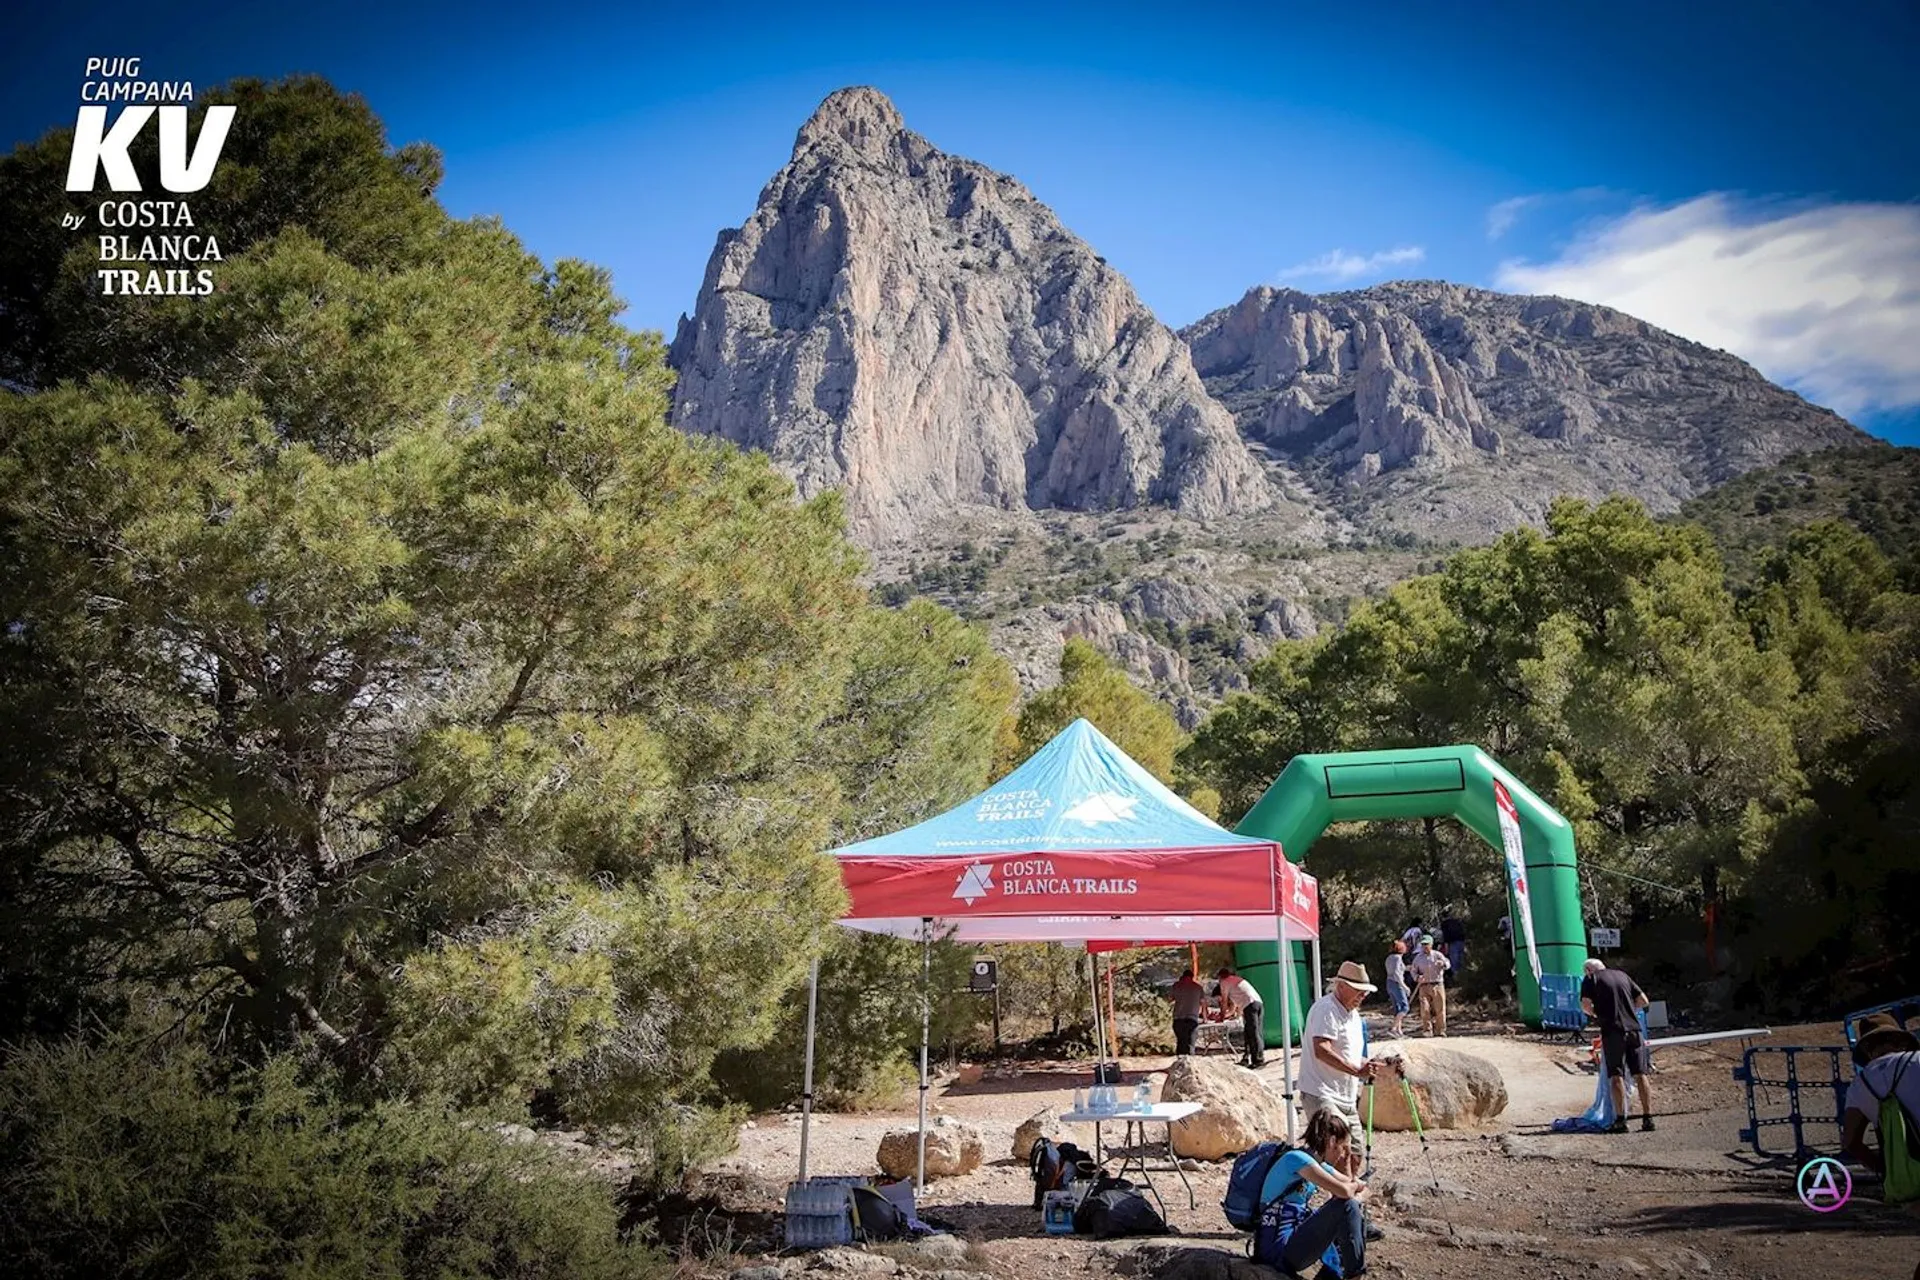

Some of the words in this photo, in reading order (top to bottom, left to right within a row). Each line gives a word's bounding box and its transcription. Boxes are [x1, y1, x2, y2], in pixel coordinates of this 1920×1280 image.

[983, 789, 1039, 802] COSTA
[979, 798, 1053, 812] BLANCA
[975, 808, 1045, 822] TRAILS
[1002, 860, 1056, 877] COSTA
[1002, 879, 1071, 896] BLANCA
[1073, 878, 1138, 895] TRAILS
